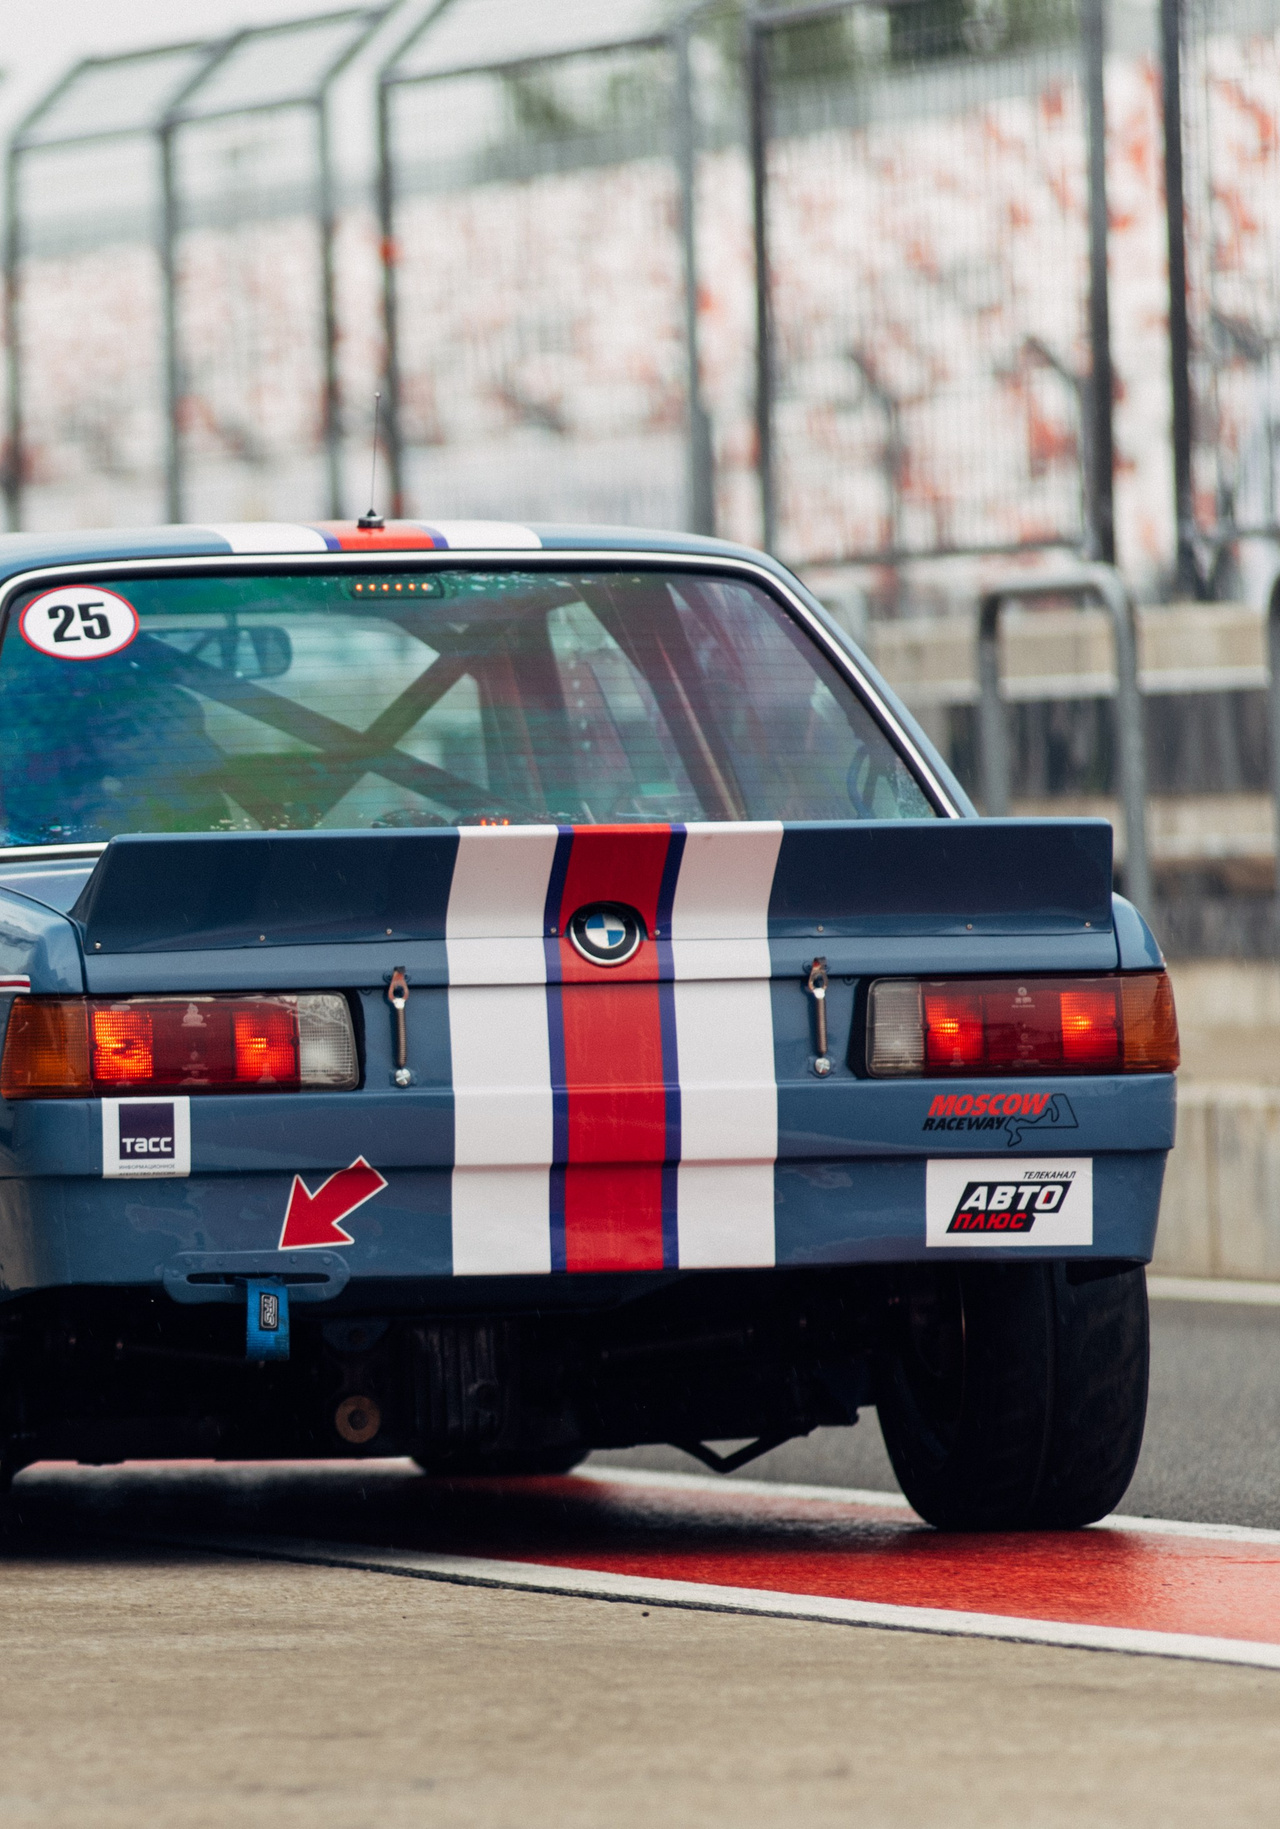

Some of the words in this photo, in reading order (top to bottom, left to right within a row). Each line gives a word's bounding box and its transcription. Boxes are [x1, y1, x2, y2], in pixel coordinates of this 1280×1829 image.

[48, 602, 111, 642] 25
[927, 1092, 1050, 1116] MOSCOW
[922, 1116, 1007, 1131] RACEWAY
[1023, 1171, 1076, 1179] ТЕЛЕКАНАЛ
[960, 1185, 1063, 1210] АВТО
[953, 1213, 1027, 1229] ПЛЮС
